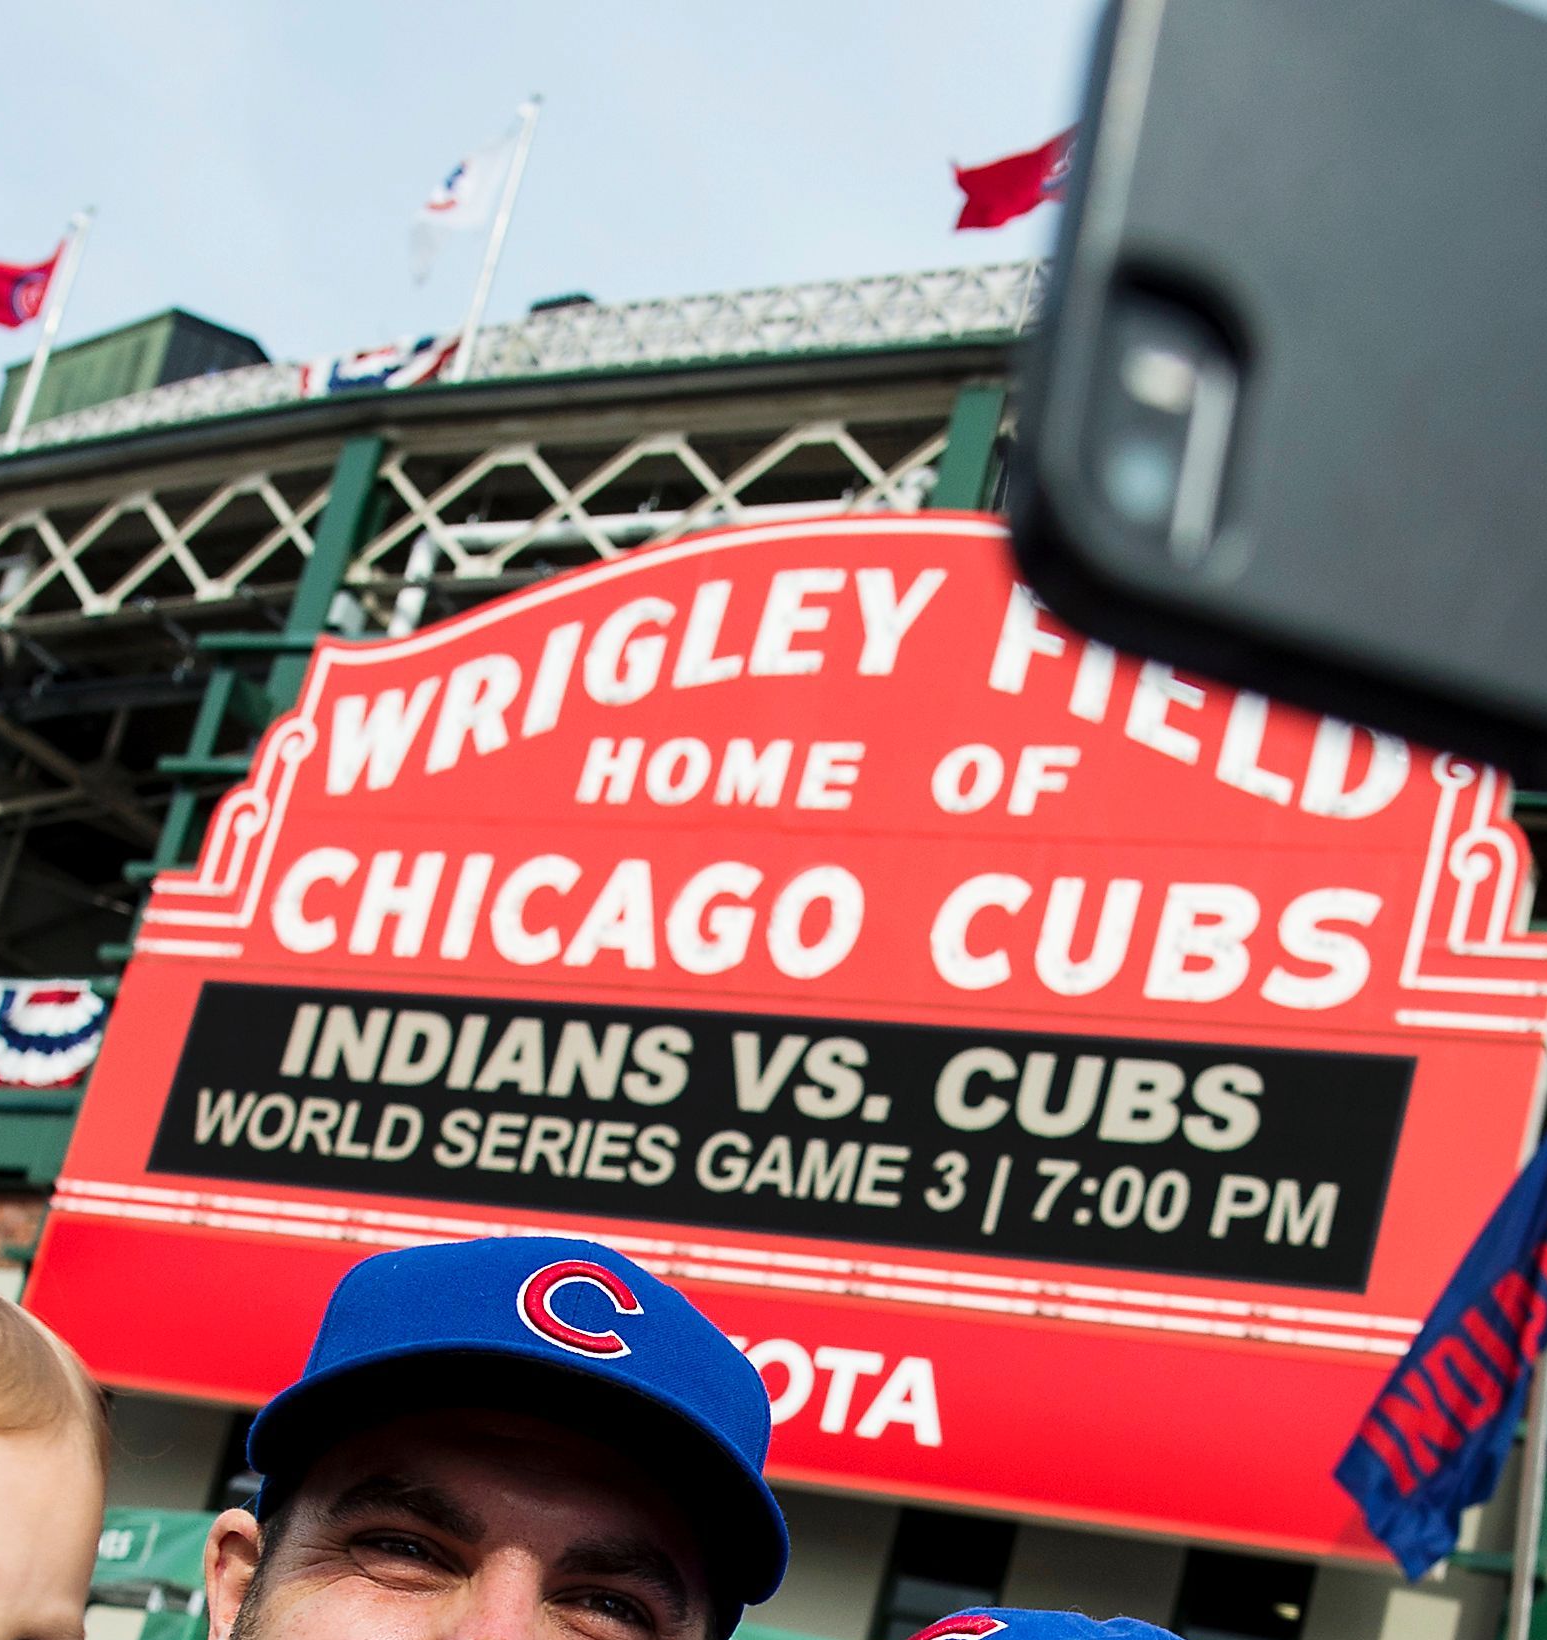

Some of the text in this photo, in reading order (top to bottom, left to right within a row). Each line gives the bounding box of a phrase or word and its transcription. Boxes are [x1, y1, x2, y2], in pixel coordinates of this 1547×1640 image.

[326, 567, 1412, 820] WRIGLEY FIELD
[576, 737, 1081, 816] HOME OF
[270, 846, 1384, 1010] CHICAGO CUBS
[279, 1003, 1264, 1152] INDIANS VS. CUBS
[193, 1088, 424, 1162] WORLD
[433, 1107, 681, 1186] SERIES
[695, 1129, 911, 1207] GAME
[924, 1151, 968, 1212] 3
[1032, 1158, 1190, 1233] 7:00
[1208, 1174, 1339, 1248] PM
[516, 1259, 644, 1359] C
[728, 1335, 942, 1447] OTA
